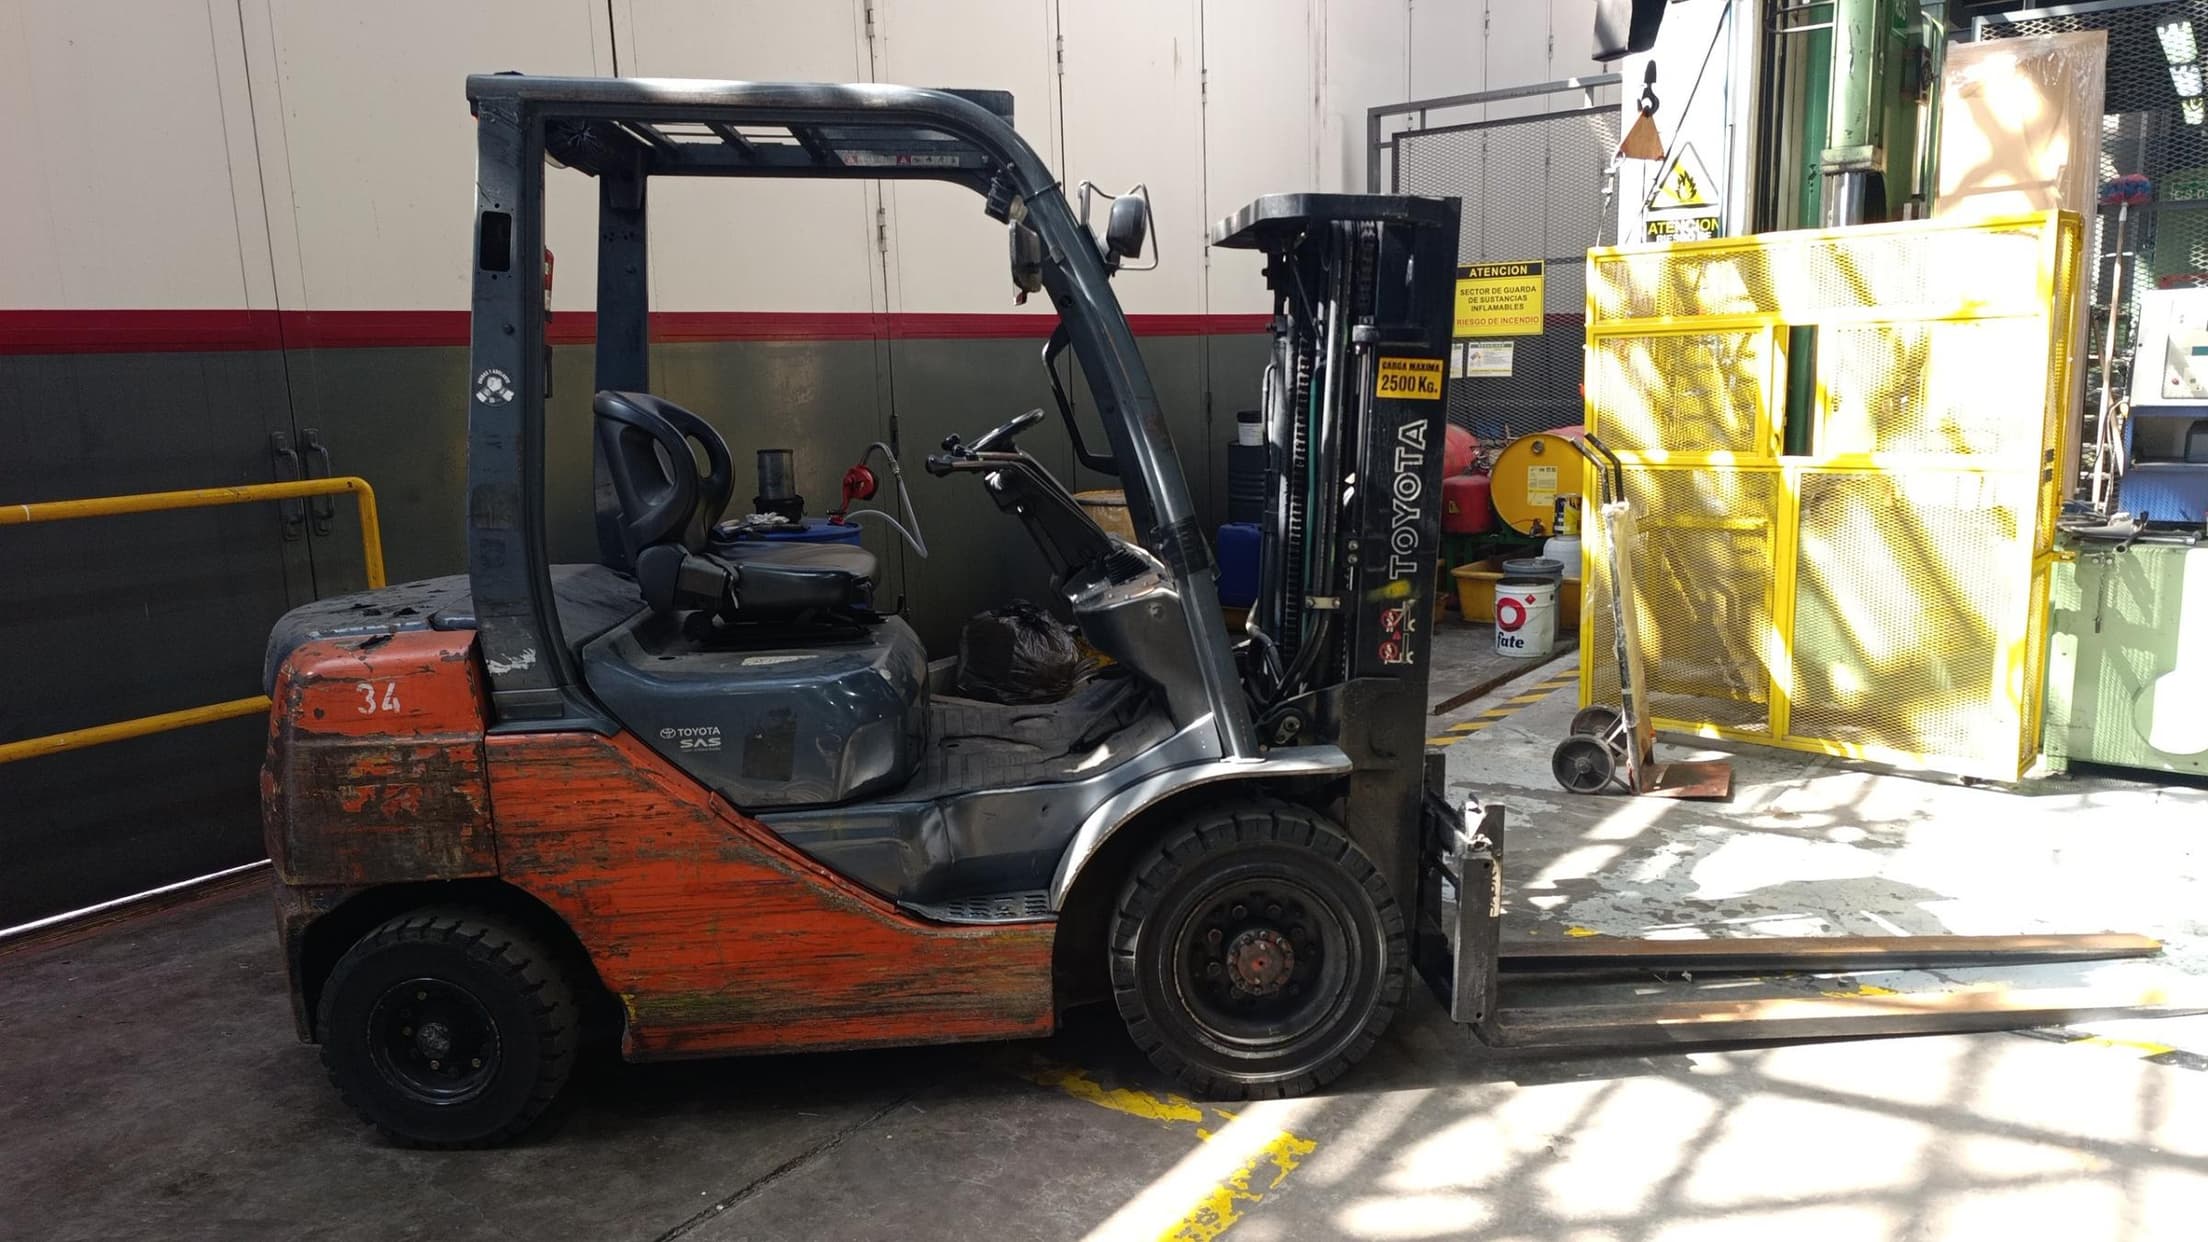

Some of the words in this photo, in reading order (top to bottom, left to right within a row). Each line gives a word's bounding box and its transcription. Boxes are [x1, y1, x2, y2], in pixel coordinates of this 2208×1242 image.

[1469, 265, 1528, 277] ATENCION
[1460, 287, 1490, 296] SECTOR
[1491, 286, 1502, 295] DE
[1504, 285, 1537, 294] GUARDA
[1480, 294, 1528, 303] SUSTANCIAS
[1471, 303, 1525, 312] INFLAMABLES
[1456, 318, 1487, 326] RIESGO
[1488, 317, 1498, 325] DE
[1500, 315, 1540, 324] INCENDIO
[1381, 374, 1416, 392] 2500
[1389, 418, 1429, 580] TOYOTA
[1497, 631, 1525, 648] fate
[356, 682, 401, 715] 34
[677, 726, 721, 737] TOYOTA
[679, 737, 722, 749] SAS
